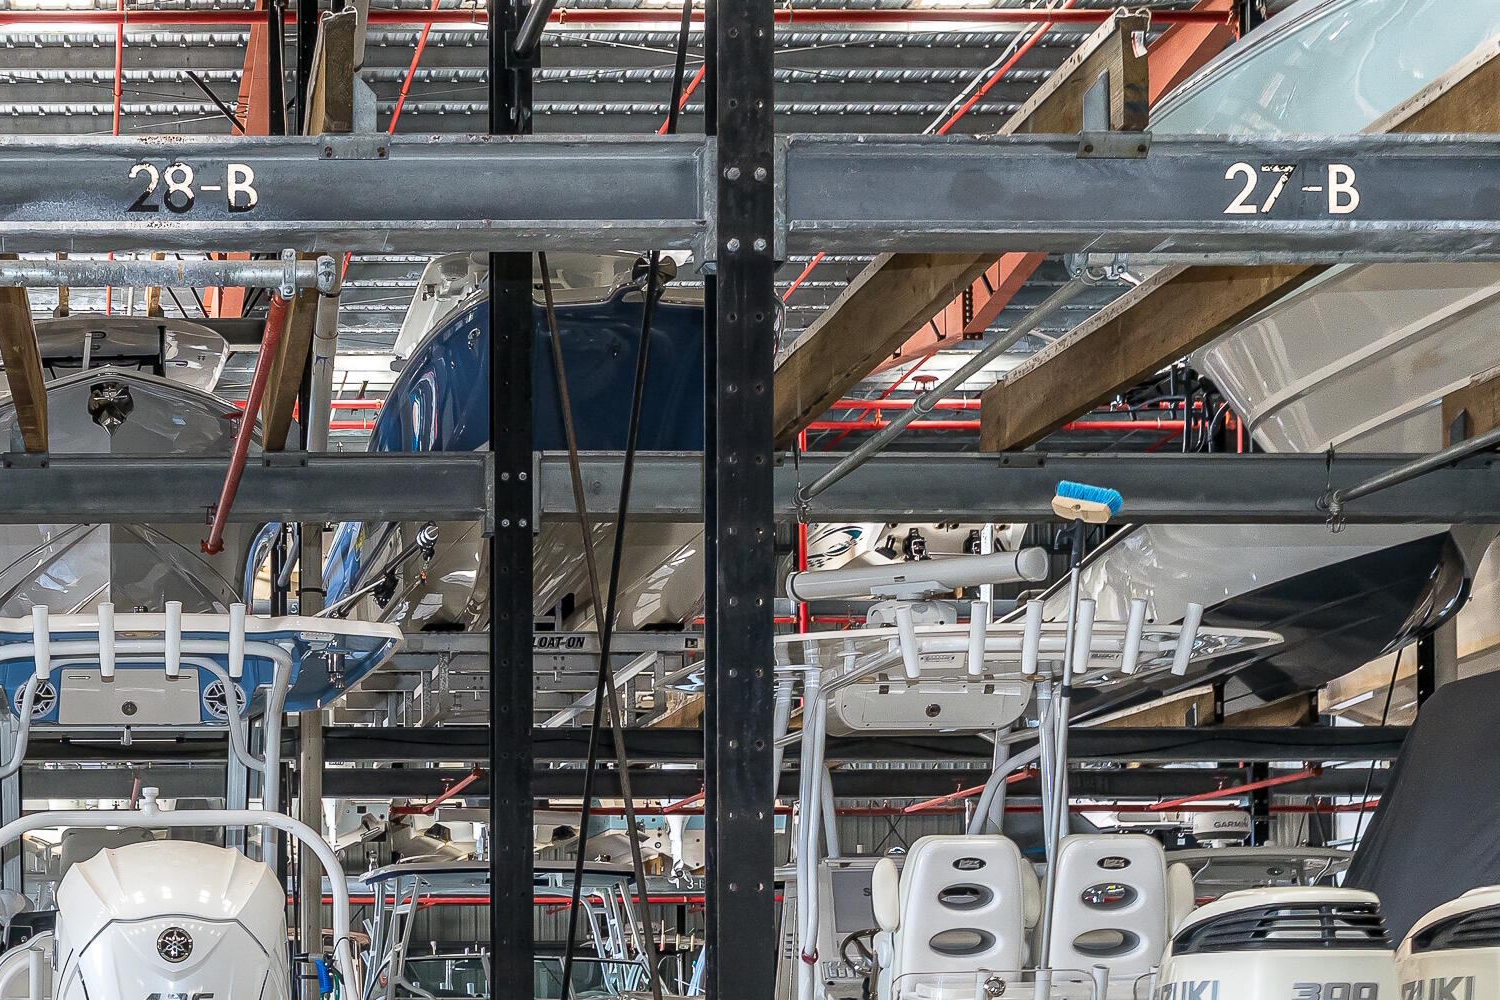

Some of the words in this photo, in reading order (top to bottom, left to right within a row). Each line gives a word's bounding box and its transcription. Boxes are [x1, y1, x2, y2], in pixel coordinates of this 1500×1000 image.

[126, 162, 259, 214] 28-B
[1222, 162, 1360, 215] 27-B
[532, 636, 586, 648] LOAT-ON
[1213, 821, 1249, 829] GARMIN
